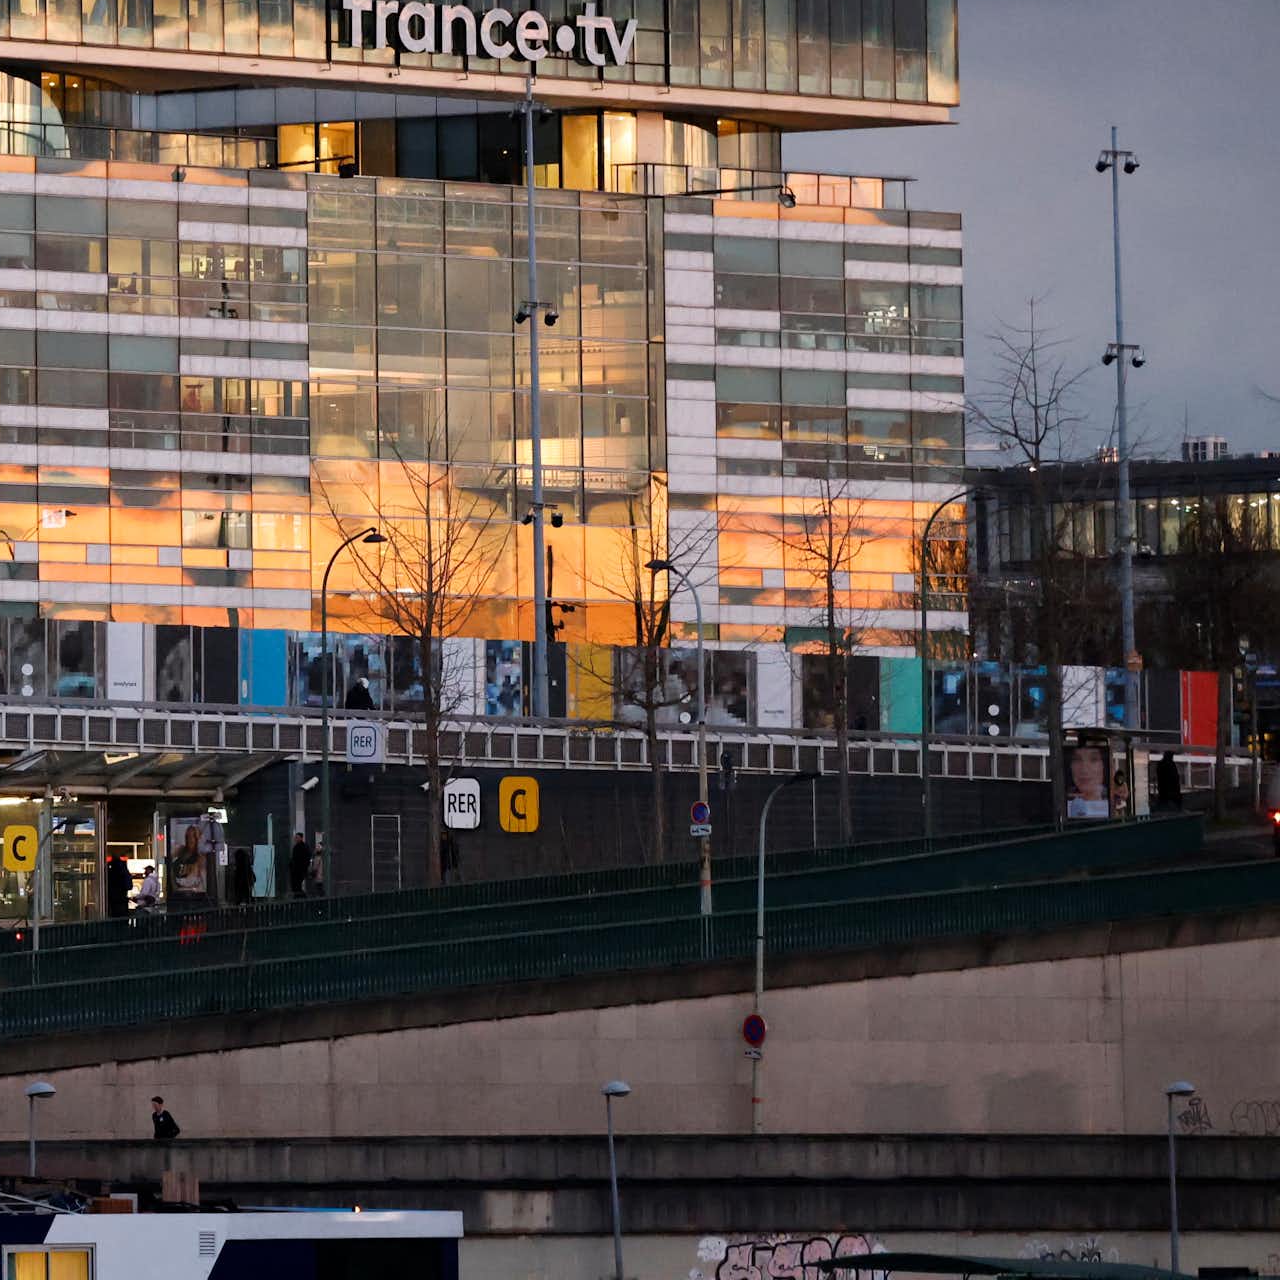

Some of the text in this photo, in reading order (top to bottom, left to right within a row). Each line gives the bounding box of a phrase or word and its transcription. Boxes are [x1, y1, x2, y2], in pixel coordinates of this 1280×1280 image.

[353, 735, 372, 748] RER
[447, 789, 527, 820] RER C
[11, 835, 26, 861] C
